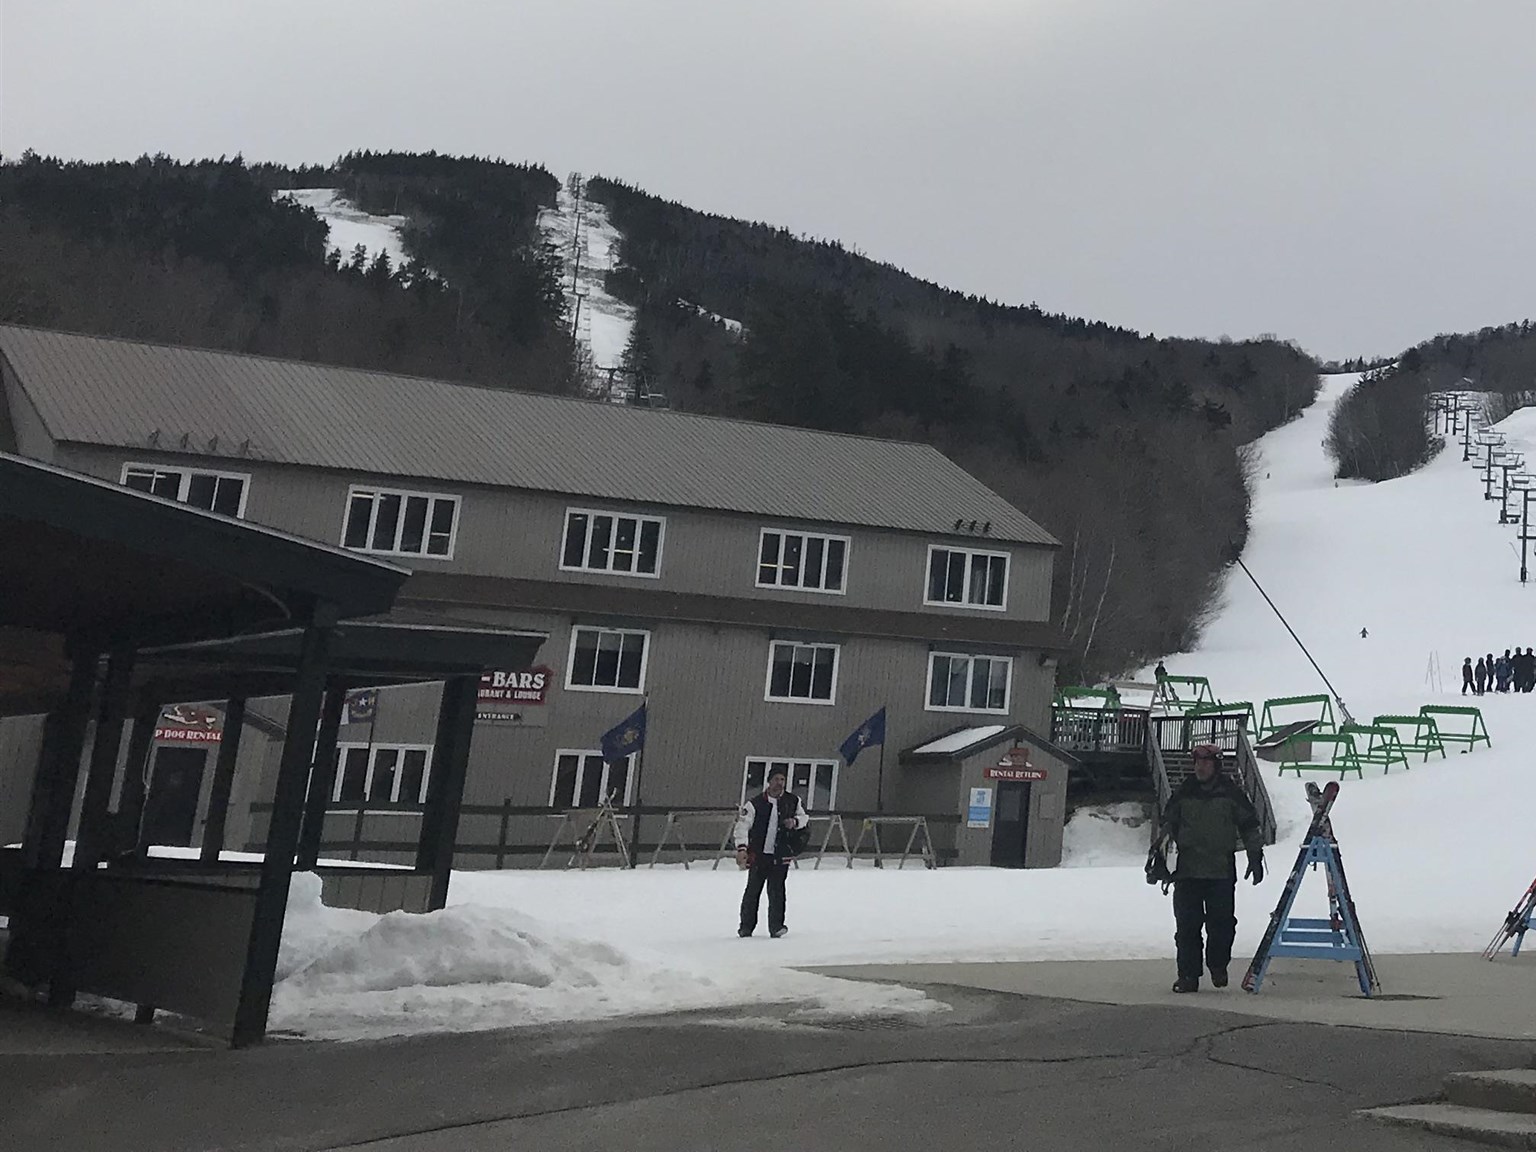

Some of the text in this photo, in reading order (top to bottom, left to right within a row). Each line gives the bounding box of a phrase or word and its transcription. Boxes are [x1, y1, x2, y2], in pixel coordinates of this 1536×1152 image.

[481, 671, 545, 689] -BARS
[478, 689, 504, 698] URANT
[514, 690, 541, 700] LOUNGE
[164, 729, 185, 739] DOG
[989, 769, 1042, 779] RENTAL RETURN
